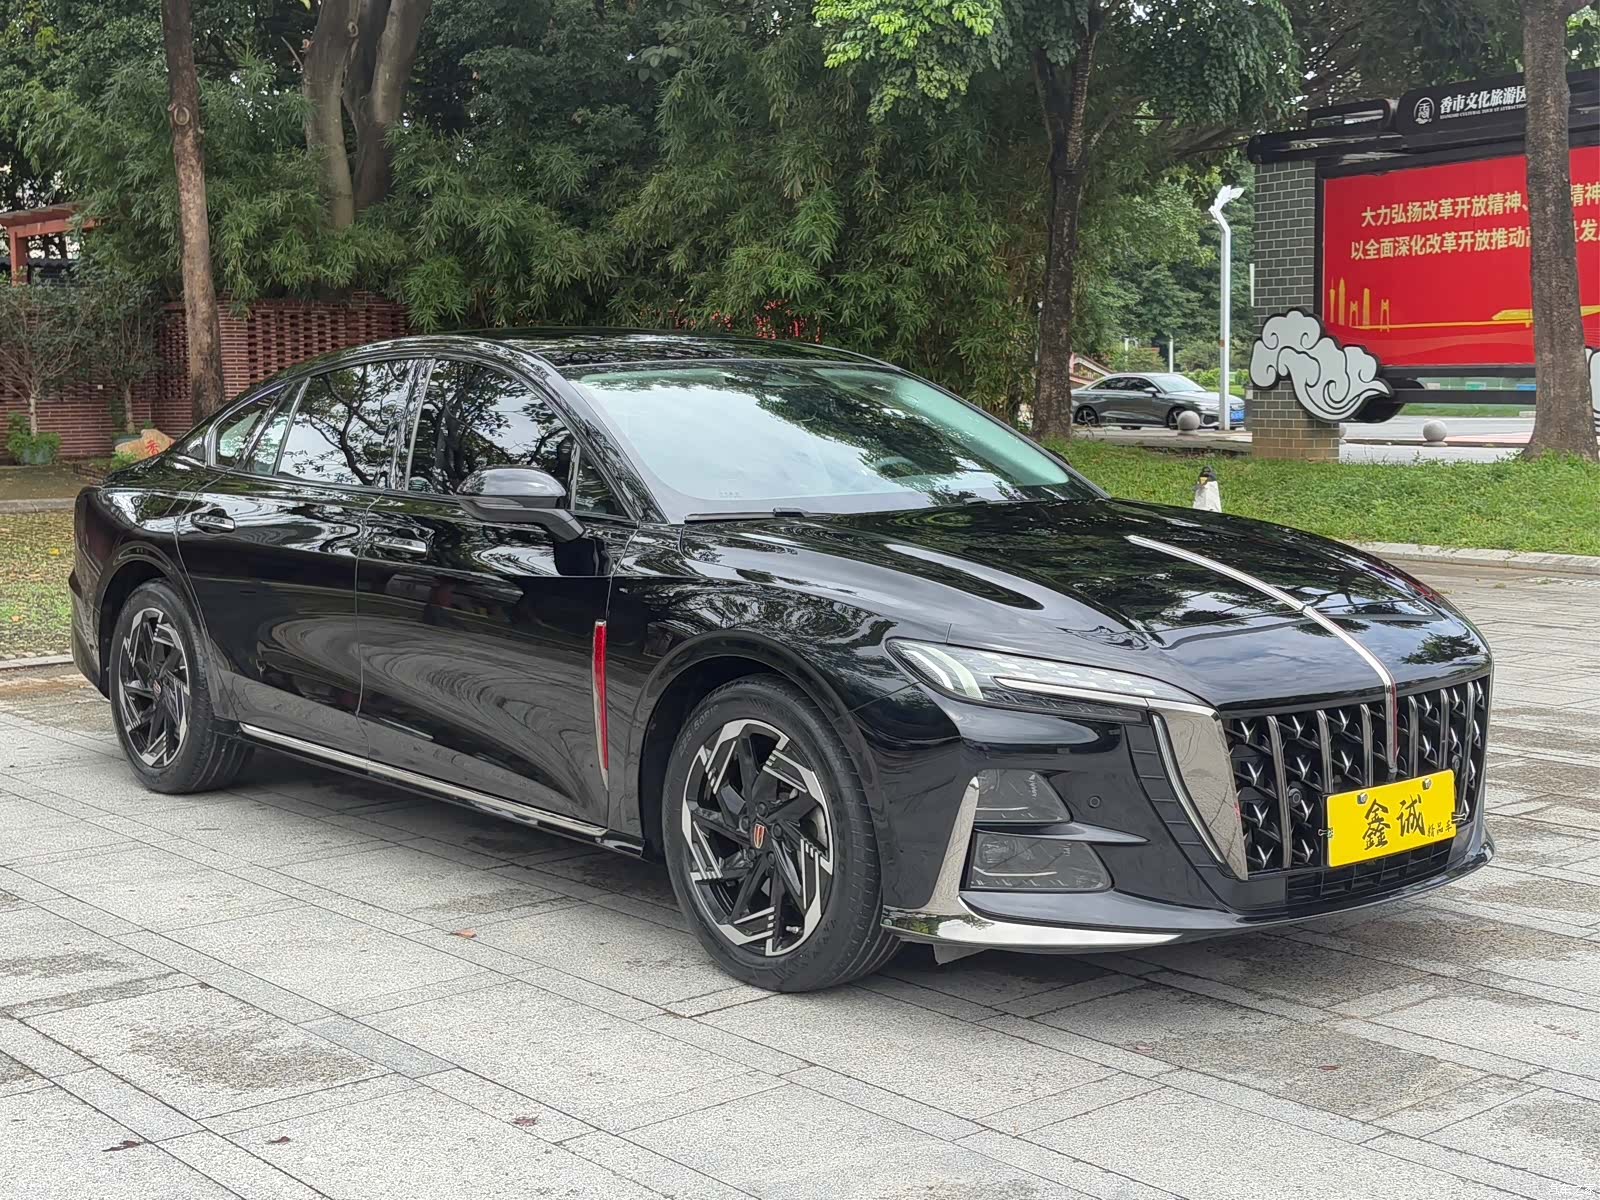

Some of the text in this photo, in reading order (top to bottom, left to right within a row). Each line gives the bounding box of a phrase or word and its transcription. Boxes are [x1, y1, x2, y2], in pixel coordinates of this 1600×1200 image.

[1440, 85, 1527, 114] 香市文化旅游区
[1362, 794, 1425, 850] 鑫诚
